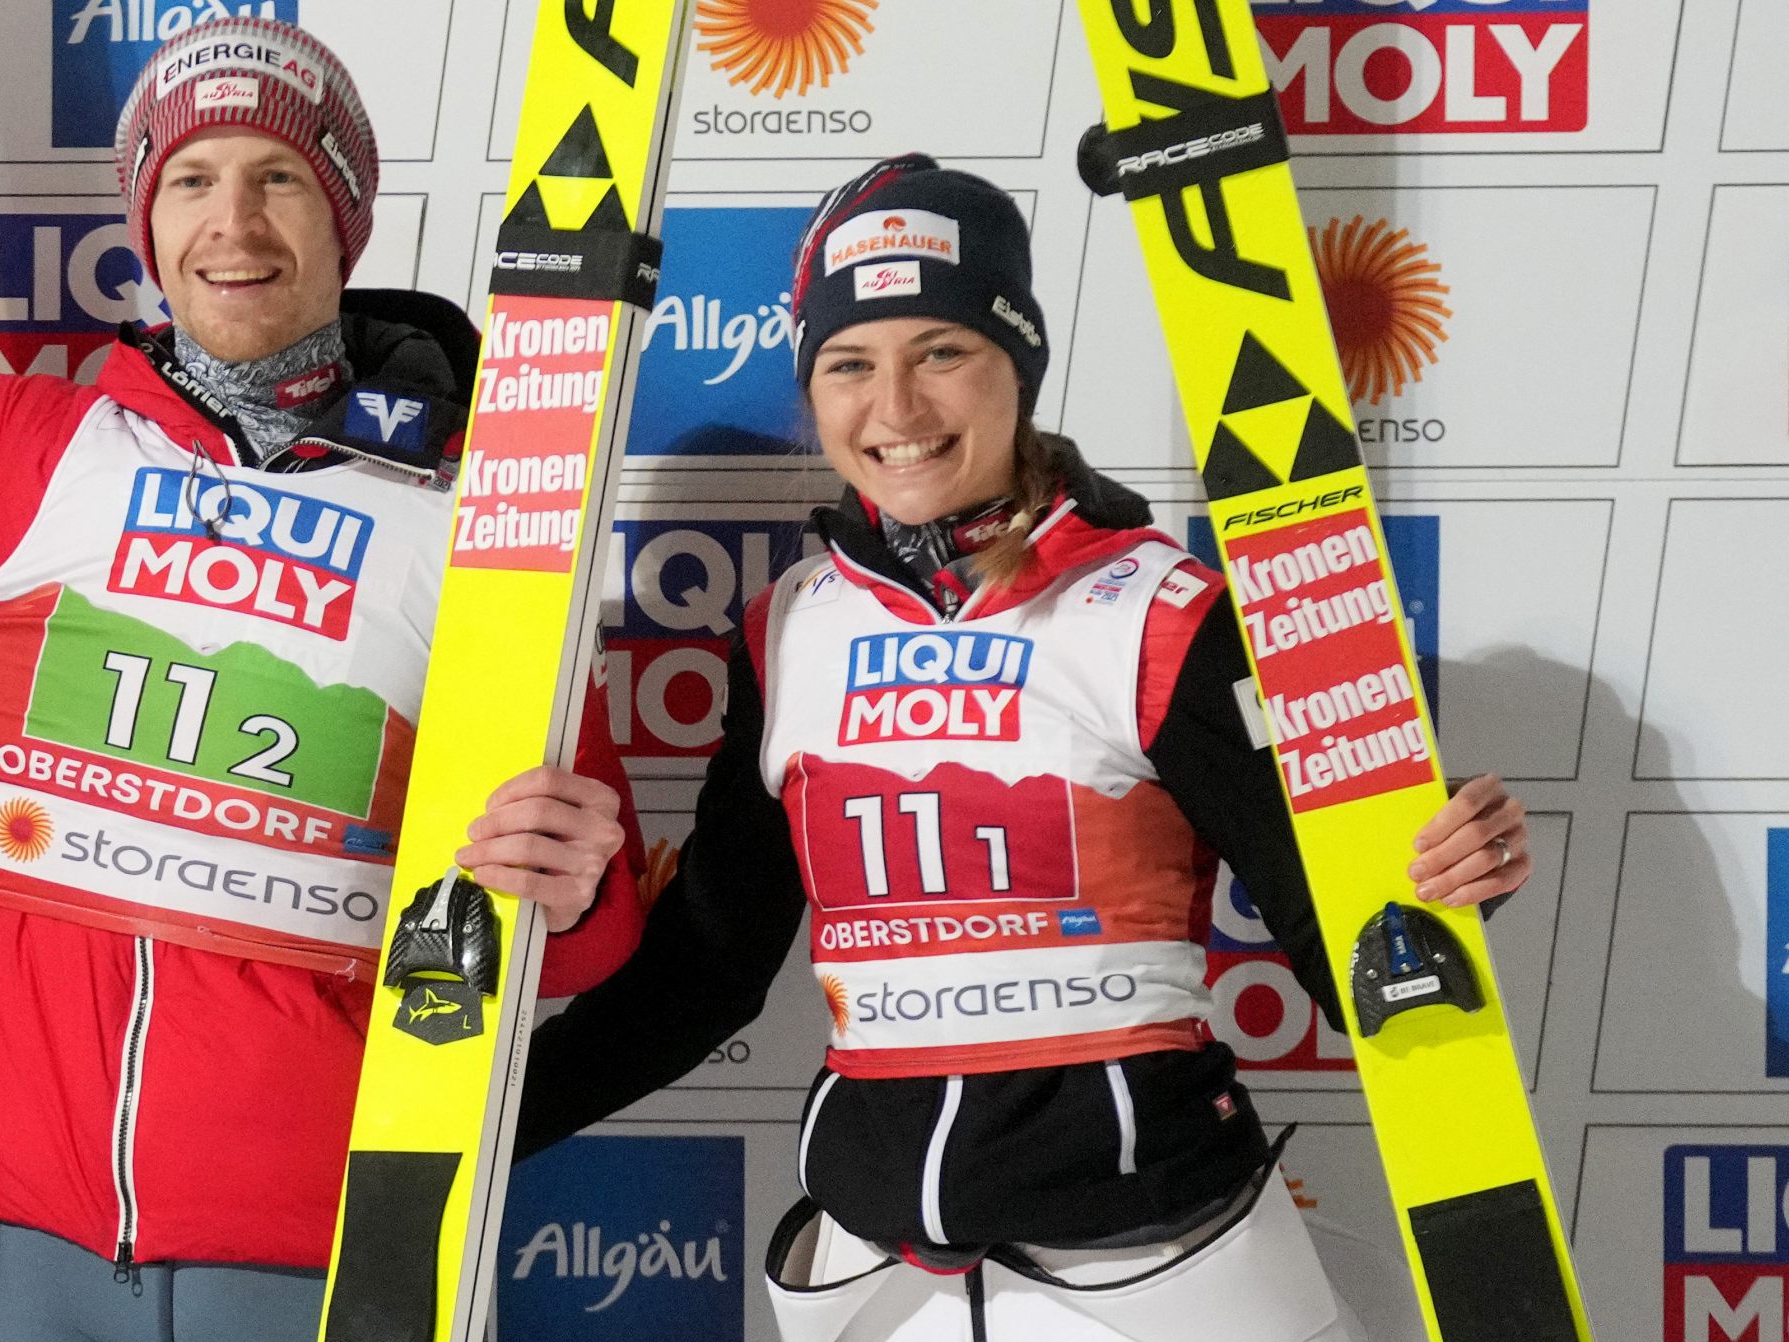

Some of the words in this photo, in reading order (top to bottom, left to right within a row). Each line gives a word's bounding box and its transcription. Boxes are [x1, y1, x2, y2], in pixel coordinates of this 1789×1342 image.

[831, 233, 952, 267] HASENAUER
[482, 312, 609, 359] Kronen
[285, 368, 336, 399] Tirol
[477, 364, 604, 413] Zeitung
[461, 449, 586, 498] Kronen
[135, 484, 367, 569] LIQUI
[455, 504, 581, 551] Zeitung
[1223, 484, 1363, 531] FISCHER
[118, 537, 354, 629] MOLY
[1229, 524, 1377, 608] Kronen
[1243, 574, 1397, 660] Zeitung
[854, 634, 1027, 688] LIQUI
[103, 650, 218, 767] 11
[226, 713, 300, 788] 2
[844, 688, 1021, 741] MOLY
[1264, 662, 1416, 746] Kronen
[1280, 713, 1435, 799] Zeitung
[845, 791, 948, 896] 11
[975, 826, 1010, 892] 1
[820, 912, 1049, 950] OBERSTDORF
